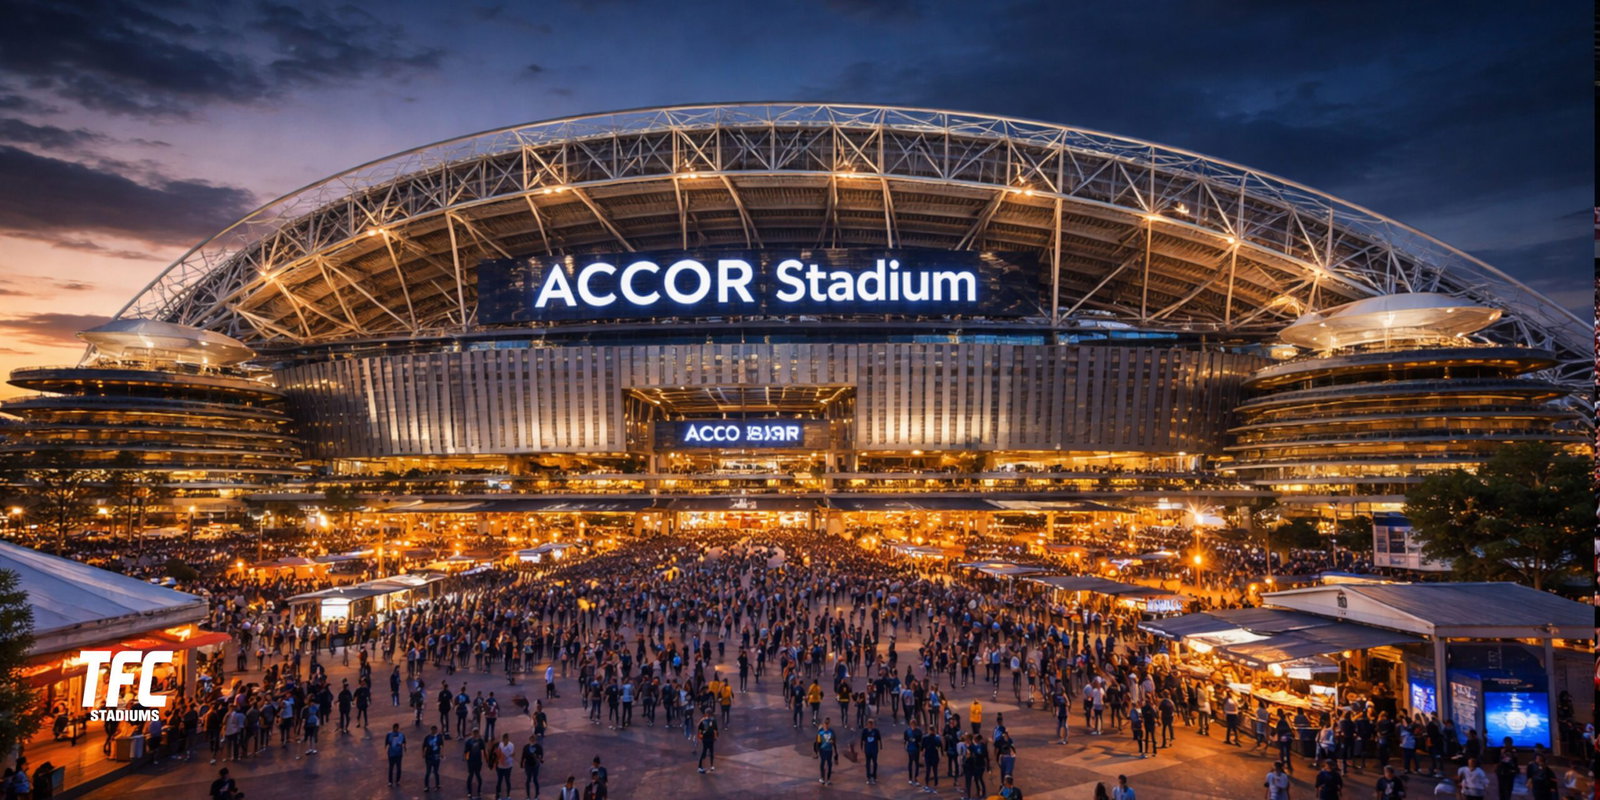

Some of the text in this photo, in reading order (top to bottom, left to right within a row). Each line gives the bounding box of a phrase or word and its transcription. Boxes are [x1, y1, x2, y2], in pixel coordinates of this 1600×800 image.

[535, 259, 977, 308] ACCOR Stadium
[684, 424, 741, 442] ACCO
